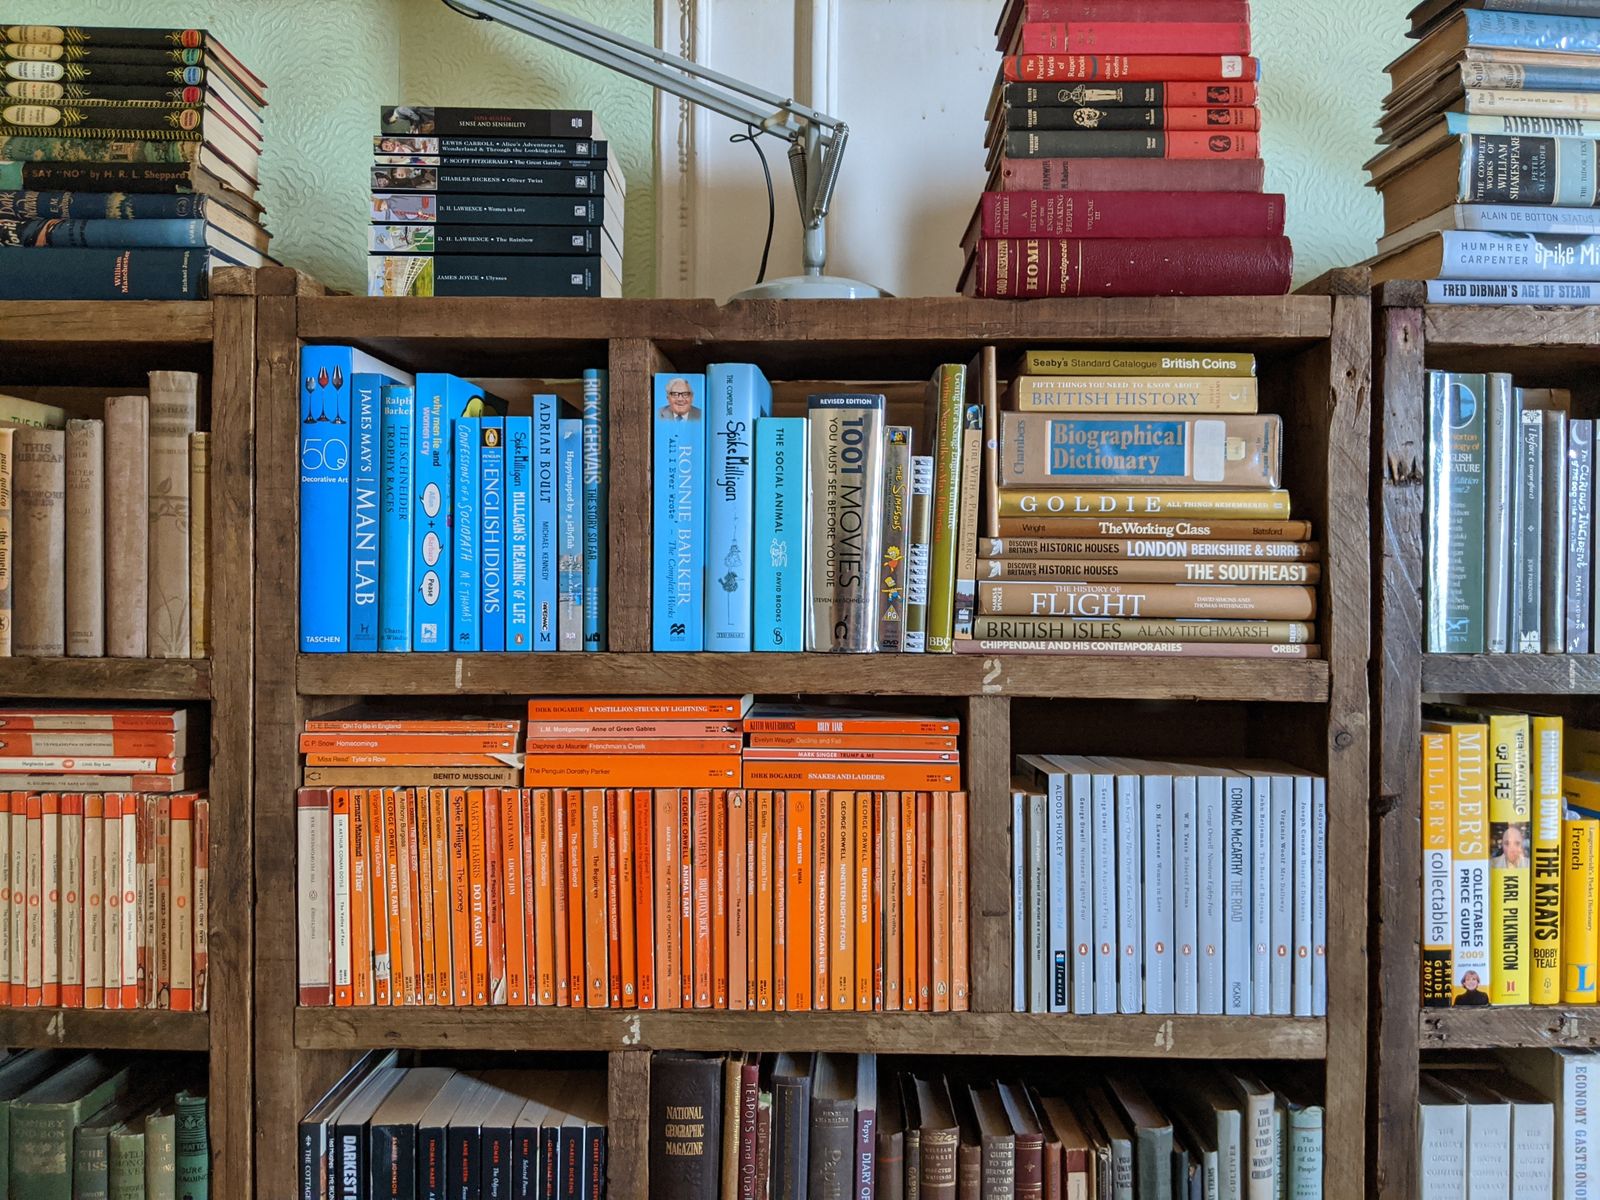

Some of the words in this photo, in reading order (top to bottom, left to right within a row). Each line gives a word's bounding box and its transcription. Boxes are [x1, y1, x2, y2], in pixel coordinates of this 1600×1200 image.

[1504, 116, 1584, 136] AIRBORNE
[1478, 136, 1486, 178] COMPLETE
[1488, 144, 1494, 153] OF
[32, 170, 52, 178] SAY
[144, 171, 186, 181] Sheppard
[1498, 144, 1508, 191] WILLIAM
[1510, 136, 1520, 200] SHAKESPEARE
[1481, 212, 1508, 220] ALAIN
[1510, 212, 1522, 220] DE
[1525, 212, 1558, 222] BOTTON
[1461, 256, 1528, 264] CARPENTER
[1462, 243, 1528, 251] HUMPHREY
[1535, 243, 1573, 269] Spike
[114, 256, 122, 287] William
[122, 251, 130, 293] Manchester
[1027, 240, 1039, 290] HOME
[1443, 285, 1467, 297] FRED
[1470, 285, 1517, 298] DIBNAH'S
[1522, 286, 1541, 298] AGE
[1544, 286, 1556, 298] OF
[1558, 286, 1590, 298] STEAM
[1033, 358, 1068, 368] Seaby's
[1071, 359, 1110, 367] Standard
[1112, 359, 1157, 369] Catalogue
[1162, 357, 1199, 369] British
[1202, 359, 1237, 368] Coins
[359, 390, 371, 430] JAMES
[584, 379, 602, 420] RICKY
[1032, 393, 1108, 405] BRITISH
[1116, 392, 1199, 406] HISTORY
[400, 425, 409, 448] THE
[540, 403, 550, 455] ADRIAN
[828, 418, 837, 440] YOU
[1054, 424, 1184, 449] Biographical
[360, 434, 371, 472] MAY'S
[386, 425, 394, 472] TROPHY
[584, 423, 602, 484] GERVAIS
[828, 445, 837, 474] MUST
[841, 418, 863, 473] 1001
[1014, 420, 1024, 474] Chambers
[1053, 450, 1160, 474] Dictionary
[386, 477, 394, 512] RACES
[400, 451, 409, 520] SCHNEIDER
[540, 460, 550, 503] BOULT
[679, 445, 692, 522] RONNIE
[828, 479, 837, 496] SEE
[357, 488, 375, 550] MAN
[485, 469, 499, 543] ENGLISH
[513, 492, 525, 541] MILLIGAN'S
[775, 493, 783, 533] ANIMAL
[827, 500, 837, 539] BEFORE
[1021, 496, 1161, 512] GOLDIE
[839, 485, 863, 588] MOVIES
[1023, 524, 1046, 533] Wright
[1177, 523, 1210, 535] Class
[1252, 527, 1282, 536] Batsford
[513, 545, 525, 585] MEANING
[827, 543, 836, 566] YOU
[1040, 542, 1082, 553] HISTORIC
[1085, 543, 1119, 553] HOUSES
[1127, 541, 1187, 557] LONDON
[1191, 544, 1251, 556] BERKSHIRE
[1255, 544, 1262, 556] &
[1266, 544, 1307, 557] SURREY
[356, 559, 375, 605] LAB
[485, 548, 499, 613] IDIOMS
[679, 529, 692, 605] BARKER
[826, 570, 836, 587] DIE
[1185, 564, 1214, 579] THE
[1219, 565, 1306, 581] SOUTHEAST
[513, 588, 525, 601] OF
[1031, 593, 1145, 616] FLIGHT
[513, 604, 525, 624] LIFE
[987, 622, 1064, 638] BRITISH
[1073, 623, 1122, 638] ISLES
[1138, 625, 1176, 637] ALAN
[1181, 625, 1269, 637] TITCHMARSH
[981, 641, 1046, 650] CHIPPENDALE
[1048, 642, 1070, 650] AND
[1072, 642, 1089, 650] HIS
[1091, 642, 1182, 652] CONTEMPORARIES
[1272, 645, 1300, 653] ORBIS
[982, 658, 1002, 694] 2
[1430, 737, 1444, 844] MILLER'S
[1458, 732, 1481, 854] MILLER'S
[454, 796, 462, 820] Spike
[1232, 788, 1242, 826] CORMAC
[454, 824, 463, 858] Milligan
[1231, 829, 1242, 876] McCARTHY
[1572, 828, 1584, 870] French
[1535, 846, 1559, 877] THE
[474, 884, 480, 902] DO
[1231, 880, 1242, 895] THE
[1432, 852, 1447, 942] collectables
[1460, 869, 1469, 904] PRICE
[1503, 876, 1518, 903] KARL
[475, 904, 481, 912] IT
[1231, 897, 1242, 922] ROAD
[1473, 868, 1483, 947] COLLECTABLES
[1535, 880, 1558, 941] KRAYS
[474, 916, 483, 946] AGAIN
[1460, 908, 1470, 947] GUIDE
[1503, 907, 1518, 970] PILKINGTON
[1460, 951, 1483, 959] 2009
[1534, 948, 1557, 958] BOBBY
[1535, 959, 1557, 968] TEALE
[1575, 1066, 1587, 1125] ECONOMY
[666, 1106, 703, 1119] NATIONAL
[666, 1124, 704, 1137] GEOGRAPHIC
[863, 1120, 872, 1143] Pepys
[343, 1135, 356, 1193] DARKEST
[666, 1142, 703, 1155] MAGAZINE
[862, 1153, 871, 1186] DIARY
